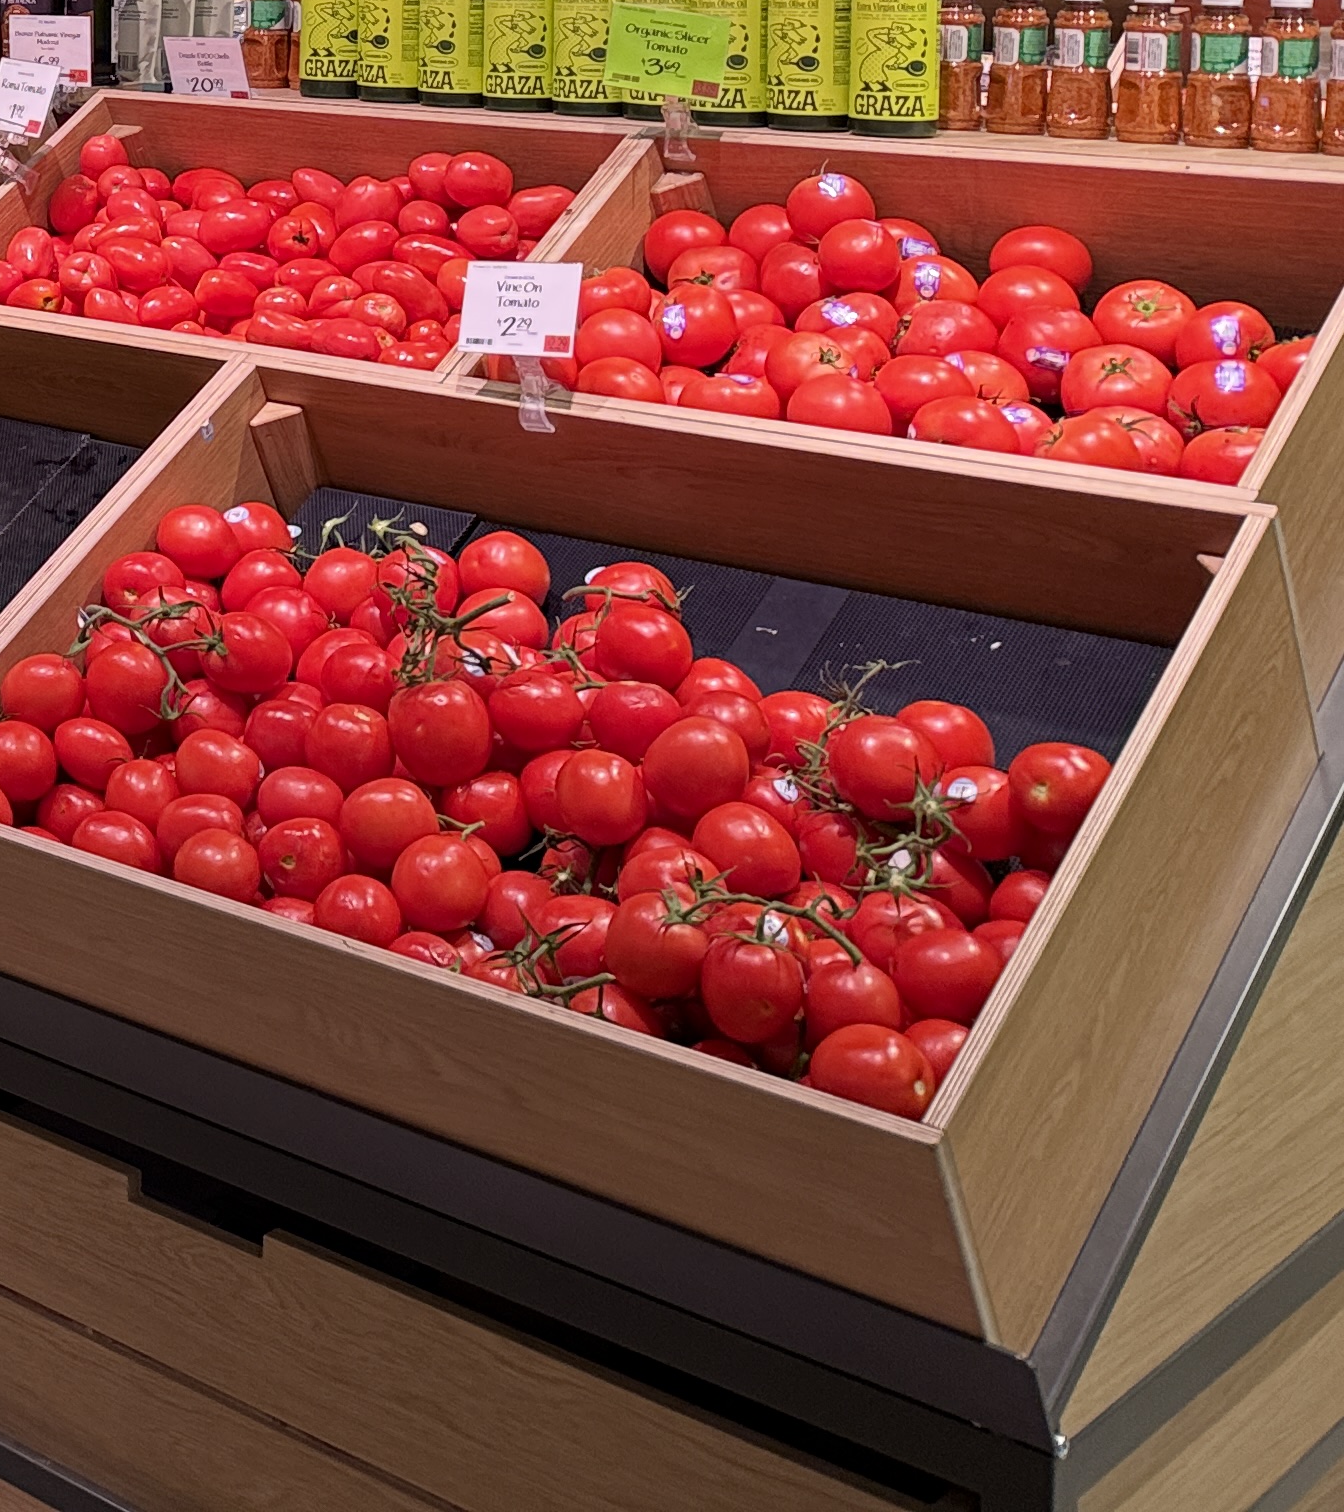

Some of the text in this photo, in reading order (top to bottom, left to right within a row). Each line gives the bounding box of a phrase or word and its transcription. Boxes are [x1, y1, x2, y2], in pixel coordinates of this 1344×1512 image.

[873, 2, 895, 13] Virgin
[896, 2, 917, 13] Olive
[918, 1, 928, 12] Oil
[625, 23, 674, 40] Organic
[674, 30, 711, 45] Slicer
[644, 39, 689, 55] Tomato
[359, 65, 389, 85] AZA
[419, 70, 455, 91] RAZA
[1, 78, 47, 96] Roma Tomato
[486, 75, 546, 96] GRAZA
[767, 90, 819, 112] RAZA
[855, 93, 926, 118] GRAZA
[496, 280, 543, 293] Vine On
[496, 295, 541, 309] Tomato
